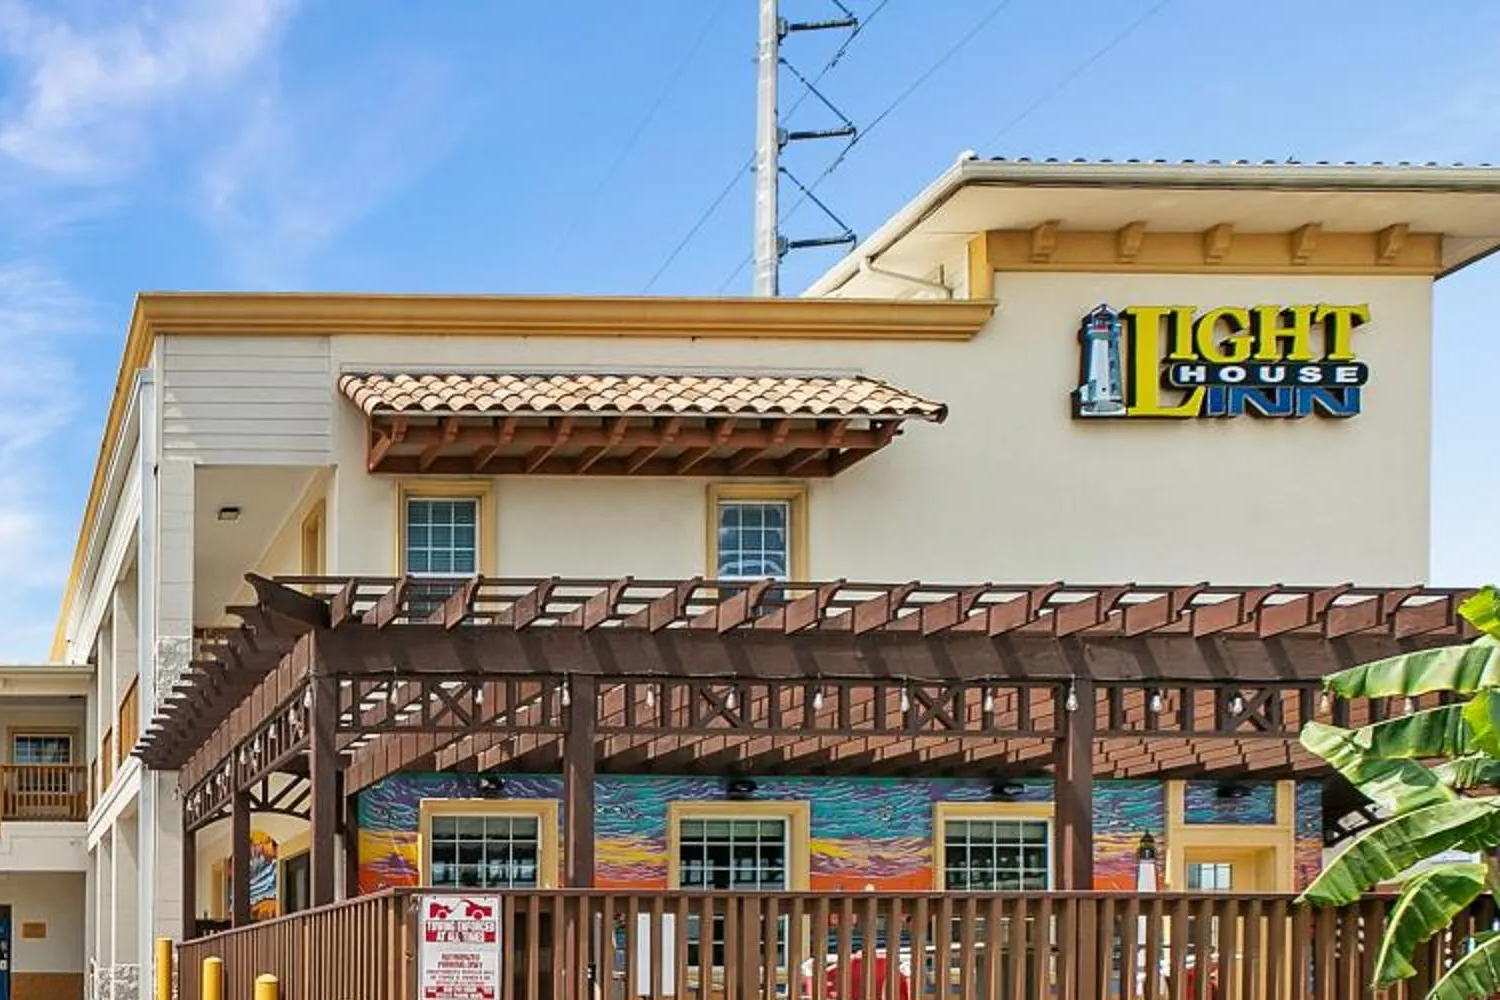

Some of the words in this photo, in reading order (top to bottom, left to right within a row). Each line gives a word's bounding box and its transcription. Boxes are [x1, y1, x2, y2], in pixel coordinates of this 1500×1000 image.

[1124, 302, 1371, 417] LIGHT
[1178, 365, 1360, 384] HOUSE
[1205, 386, 1362, 418] INN
